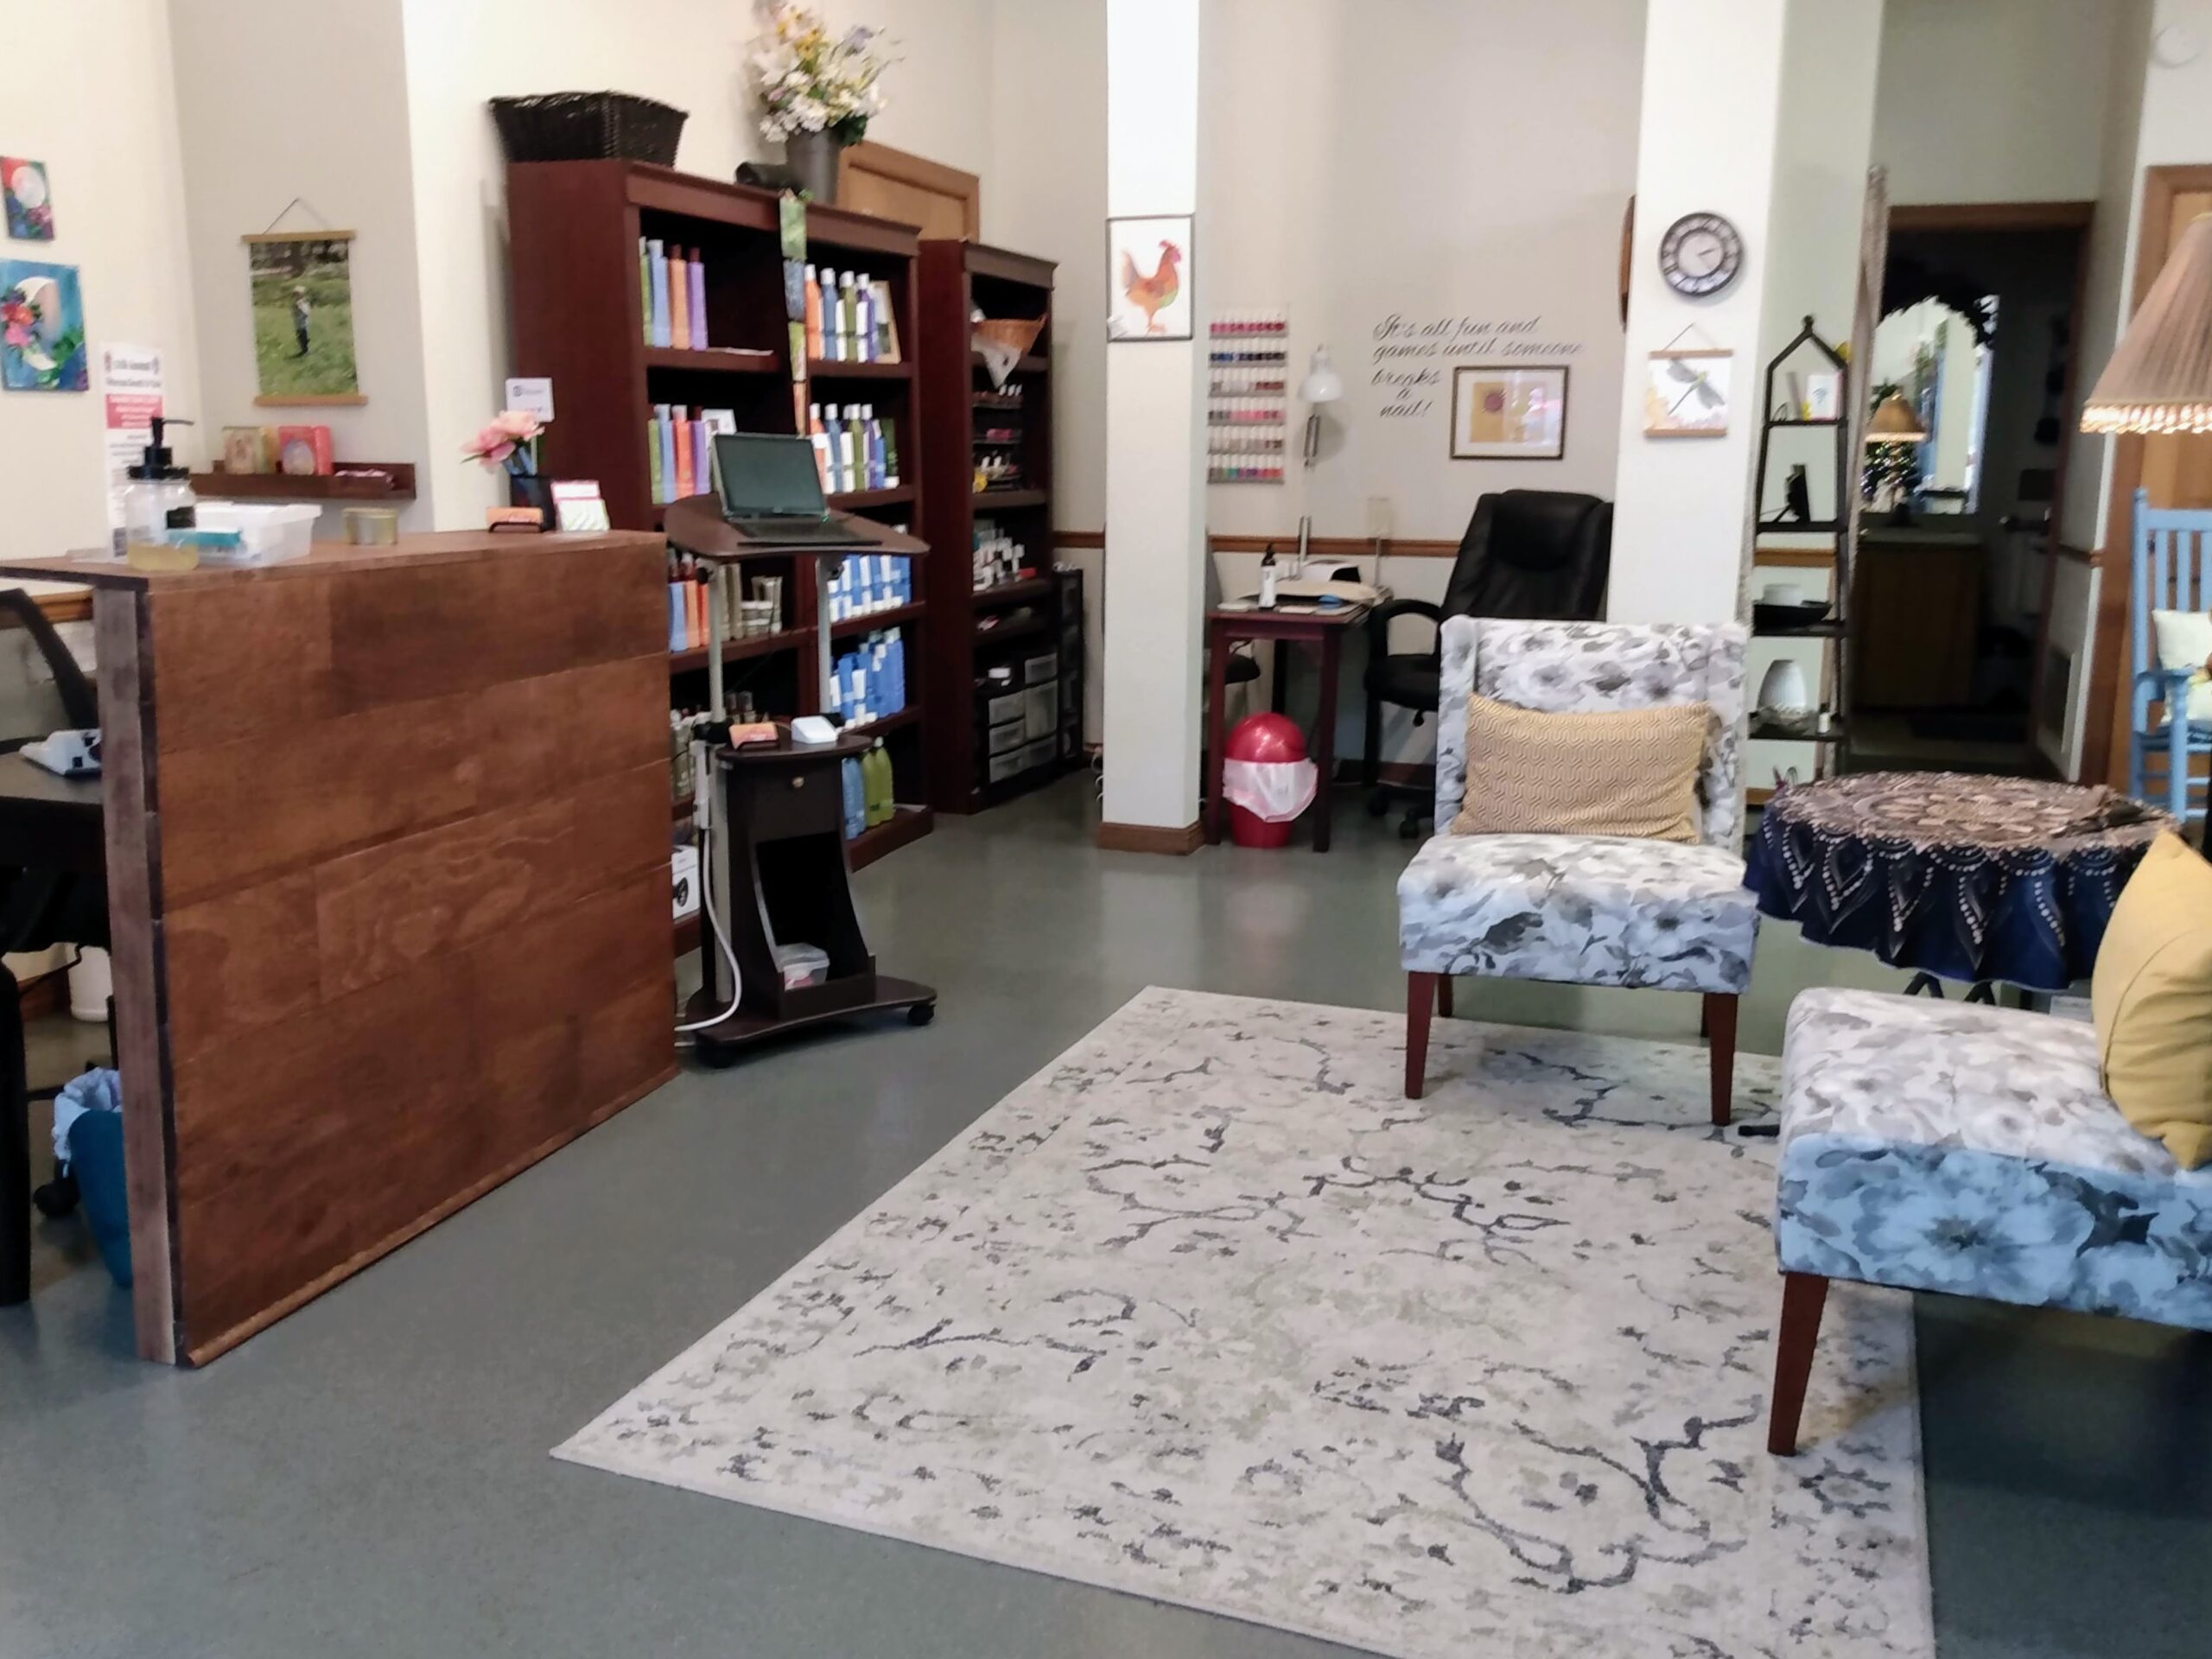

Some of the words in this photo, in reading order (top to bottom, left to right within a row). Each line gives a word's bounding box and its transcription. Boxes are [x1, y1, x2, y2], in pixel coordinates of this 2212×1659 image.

[1372, 314, 1415, 340] It's
[1421, 318, 1453, 336] all
[1450, 316, 1492, 343] fun
[1496, 315, 1541, 334] and
[1372, 342, 1439, 365] games
[1442, 338, 1497, 356] until
[1501, 341, 1583, 357] someone
[1370, 367, 1441, 385] breaks
[1395, 388, 1411, 400] a
[1380, 398, 1433, 416] nail!
